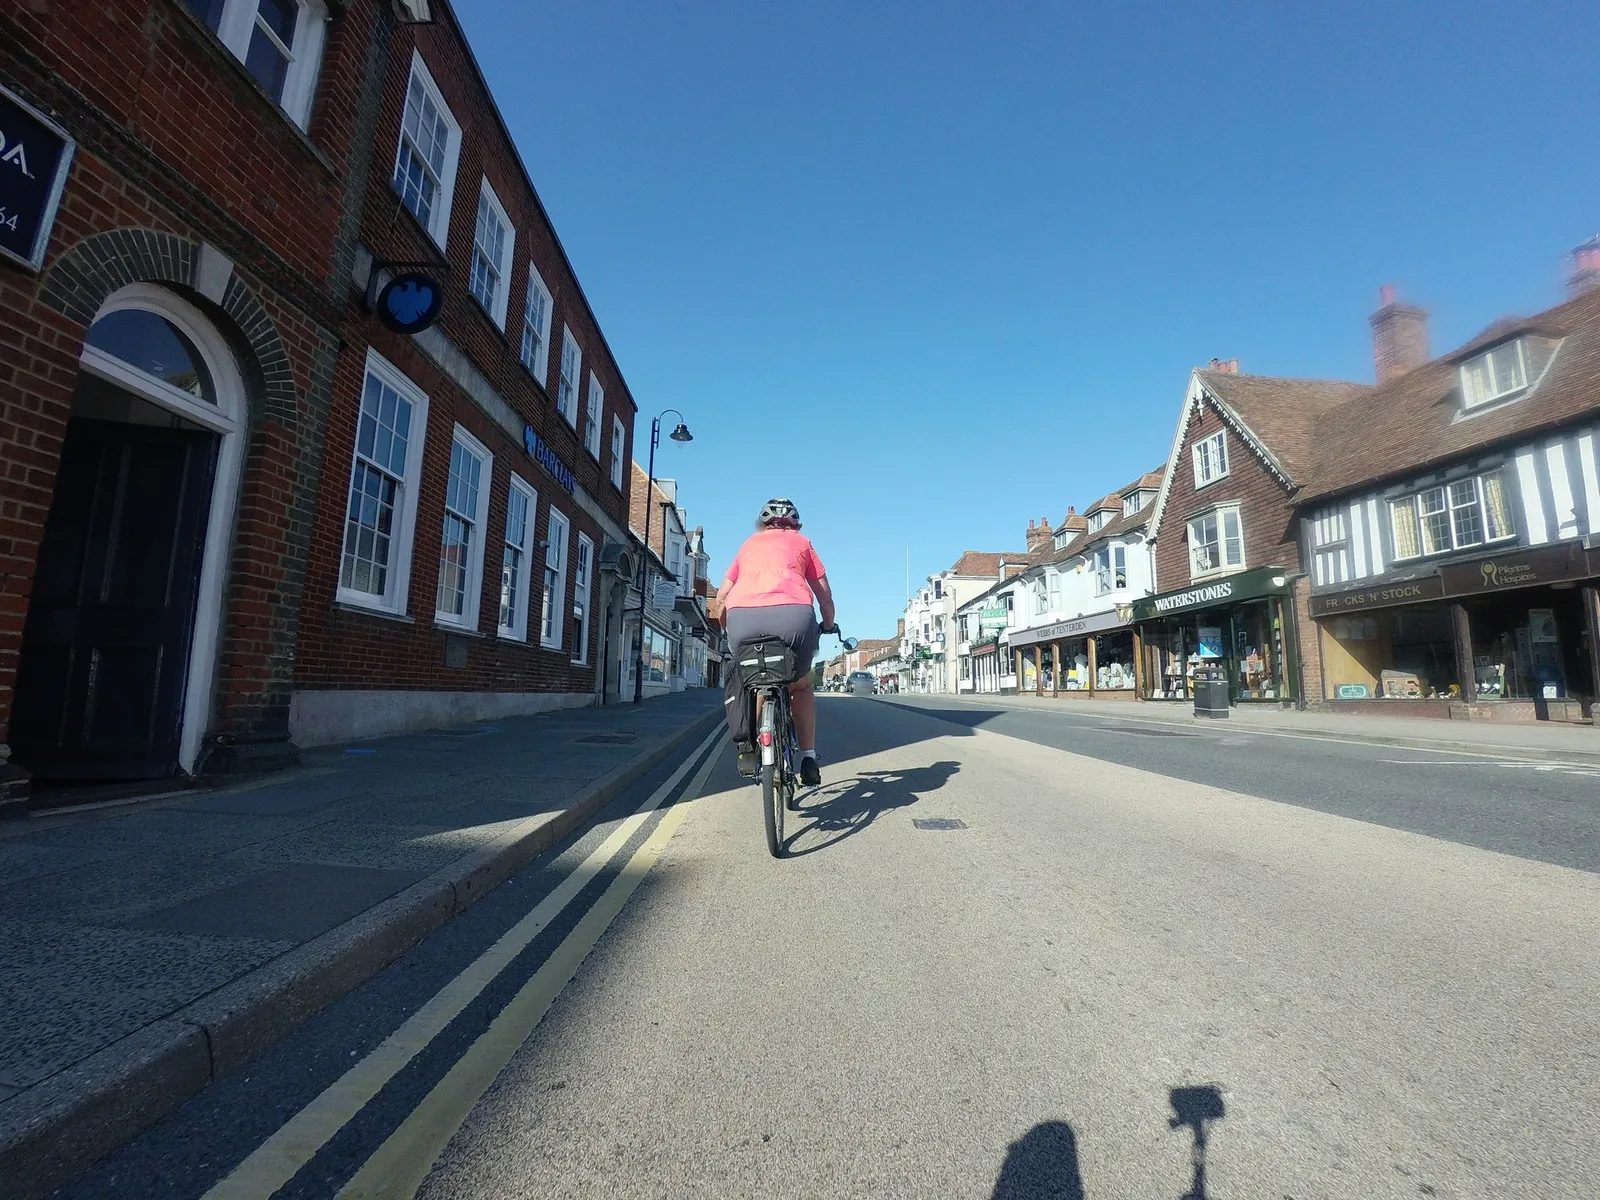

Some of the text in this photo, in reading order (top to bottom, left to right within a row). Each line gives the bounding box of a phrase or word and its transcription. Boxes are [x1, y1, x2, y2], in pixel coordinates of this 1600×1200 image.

[537, 439, 576, 495] BARCLAYS
[1498, 564, 1531, 575] Pilgrims
[1500, 573, 1537, 584] Hospices
[1154, 582, 1232, 611] WATERSTONES
[1382, 585, 1421, 600] STOCK
